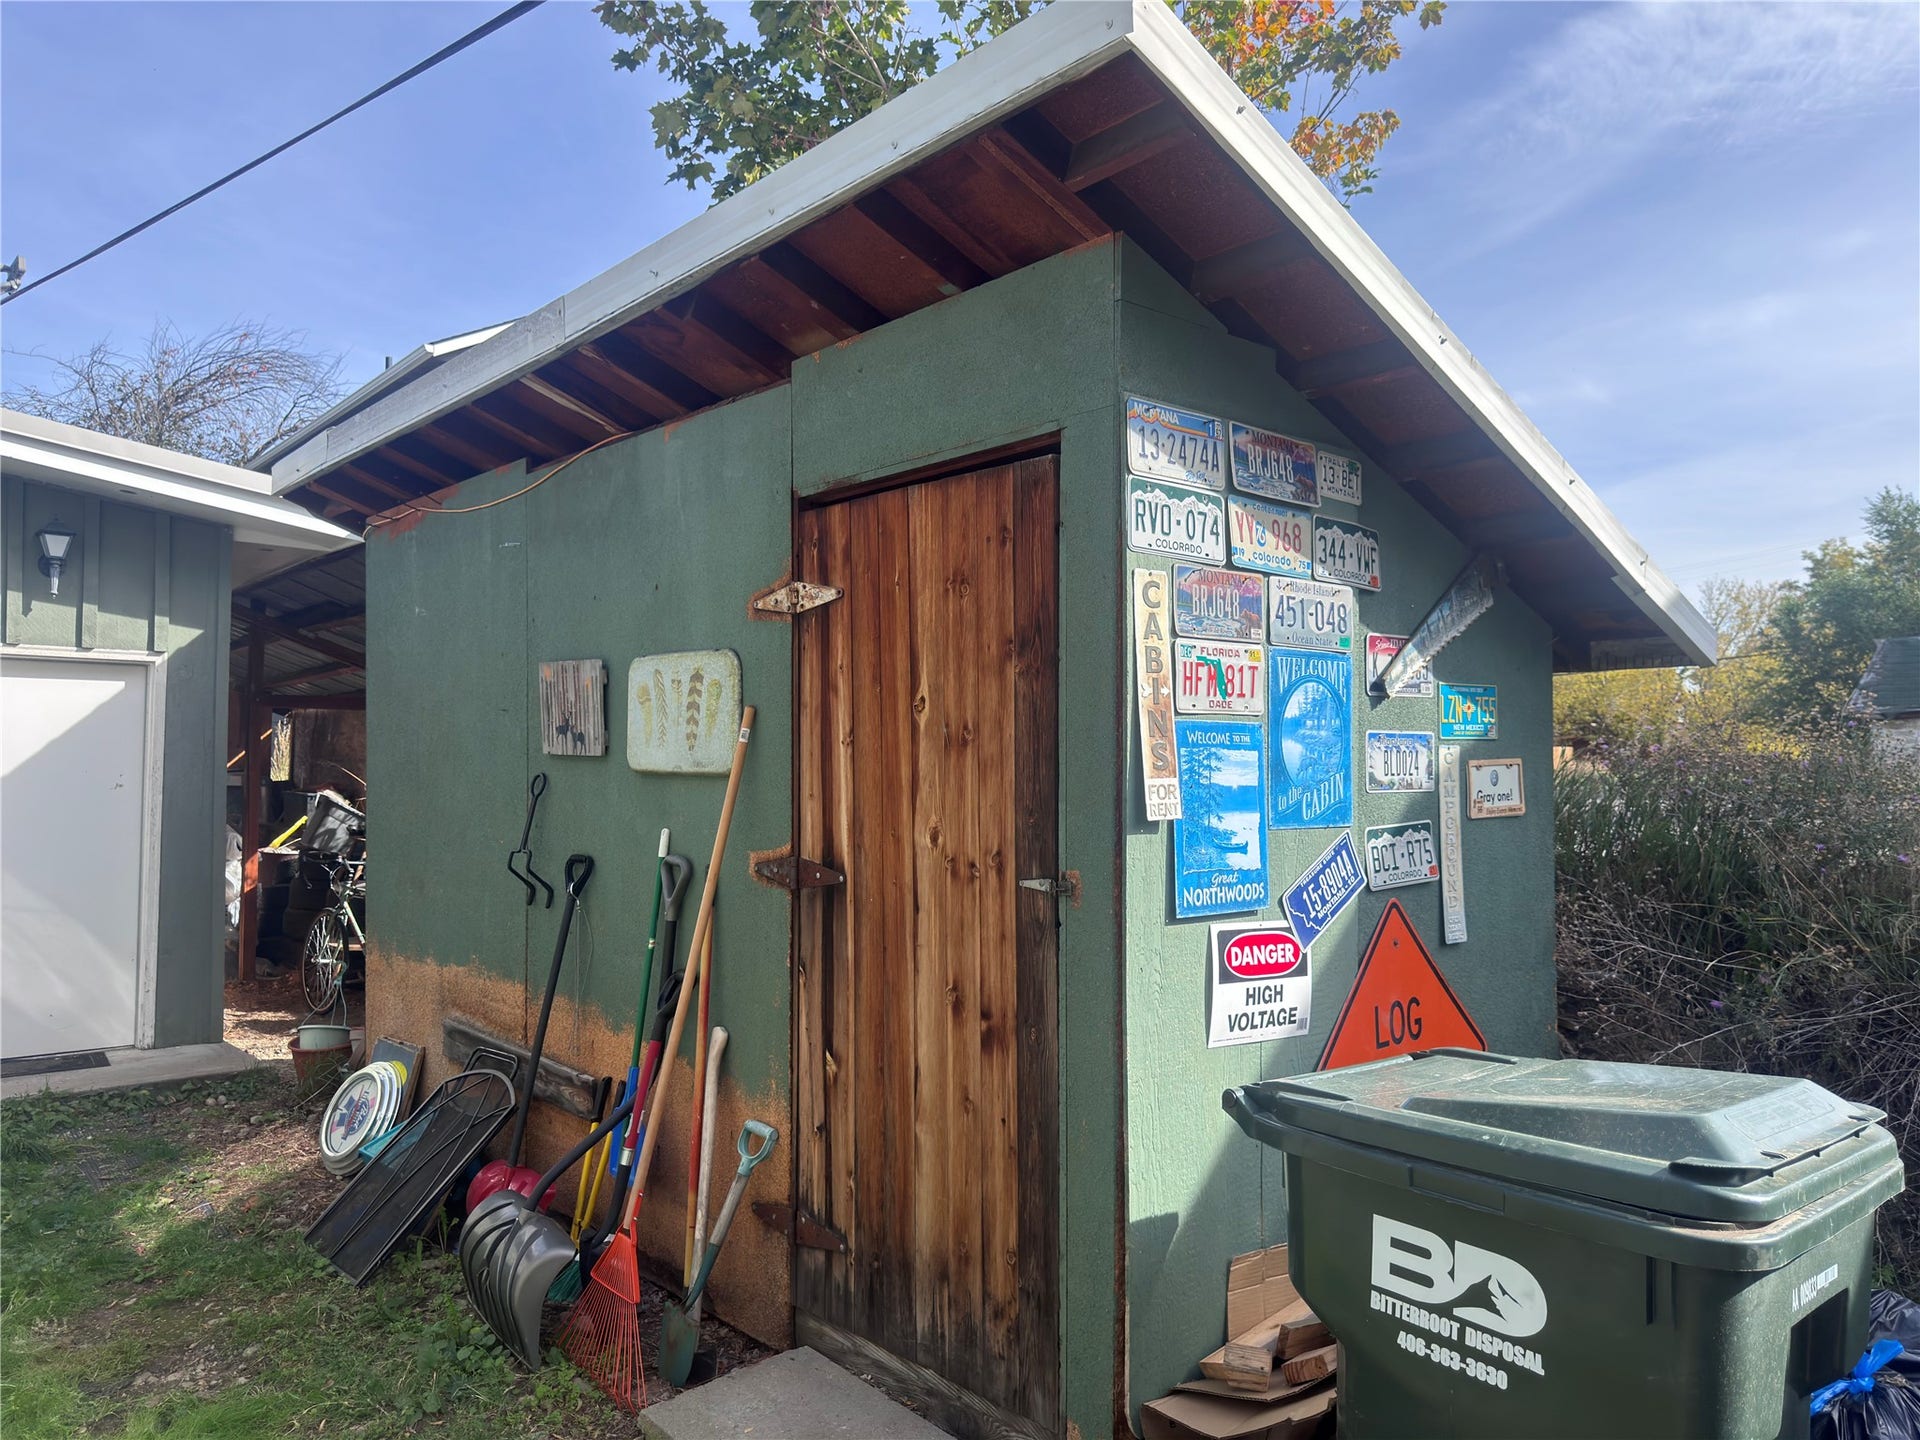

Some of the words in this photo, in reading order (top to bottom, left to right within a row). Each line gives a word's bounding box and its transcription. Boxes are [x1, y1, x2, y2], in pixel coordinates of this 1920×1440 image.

[1247, 443, 1294, 483] BRJ648
[1155, 538, 1203, 554] COLORADO
[1271, 518, 1302, 554] 968
[1252, 551, 1291, 567] colorado
[1333, 568, 1367, 583] COLORADO
[1191, 583, 1240, 620] BRJ648
[1275, 594, 1347, 634] 451-048
[1292, 632, 1314, 646] Ocean
[1315, 634, 1334, 647] State
[1200, 647, 1241, 658] FLORIDA
[1141, 580, 1170, 771] CABINS
[1277, 656, 1347, 703] WELCOME
[1208, 700, 1233, 709] DADE
[1186, 729, 1230, 745] WELCOME
[1241, 735, 1251, 743] THE
[1147, 783, 1177, 800] FOR
[1278, 794, 1287, 811] to
[1288, 783, 1302, 802] the
[1302, 771, 1345, 821] CABIN
[1476, 789, 1496, 806] Gray
[1497, 788, 1513, 802] one!
[1150, 801, 1180, 818] RENT
[1211, 871, 1239, 887] Great
[1388, 869, 1423, 882] COLORADO
[1183, 882, 1265, 908] NORTHWOODS
[1317, 887, 1346, 919] MONTANA
[1230, 943, 1295, 967] DANGER
[1245, 984, 1284, 1006] HIGH
[1228, 1006, 1298, 1033] VOLTAGE
[1374, 996, 1423, 1050] LOG
[1370, 1289, 1461, 1341] BITTERROOT
[1464, 1326, 1545, 1376] DISPOSAL
[1397, 1330, 1508, 1390] 406-363-3630
